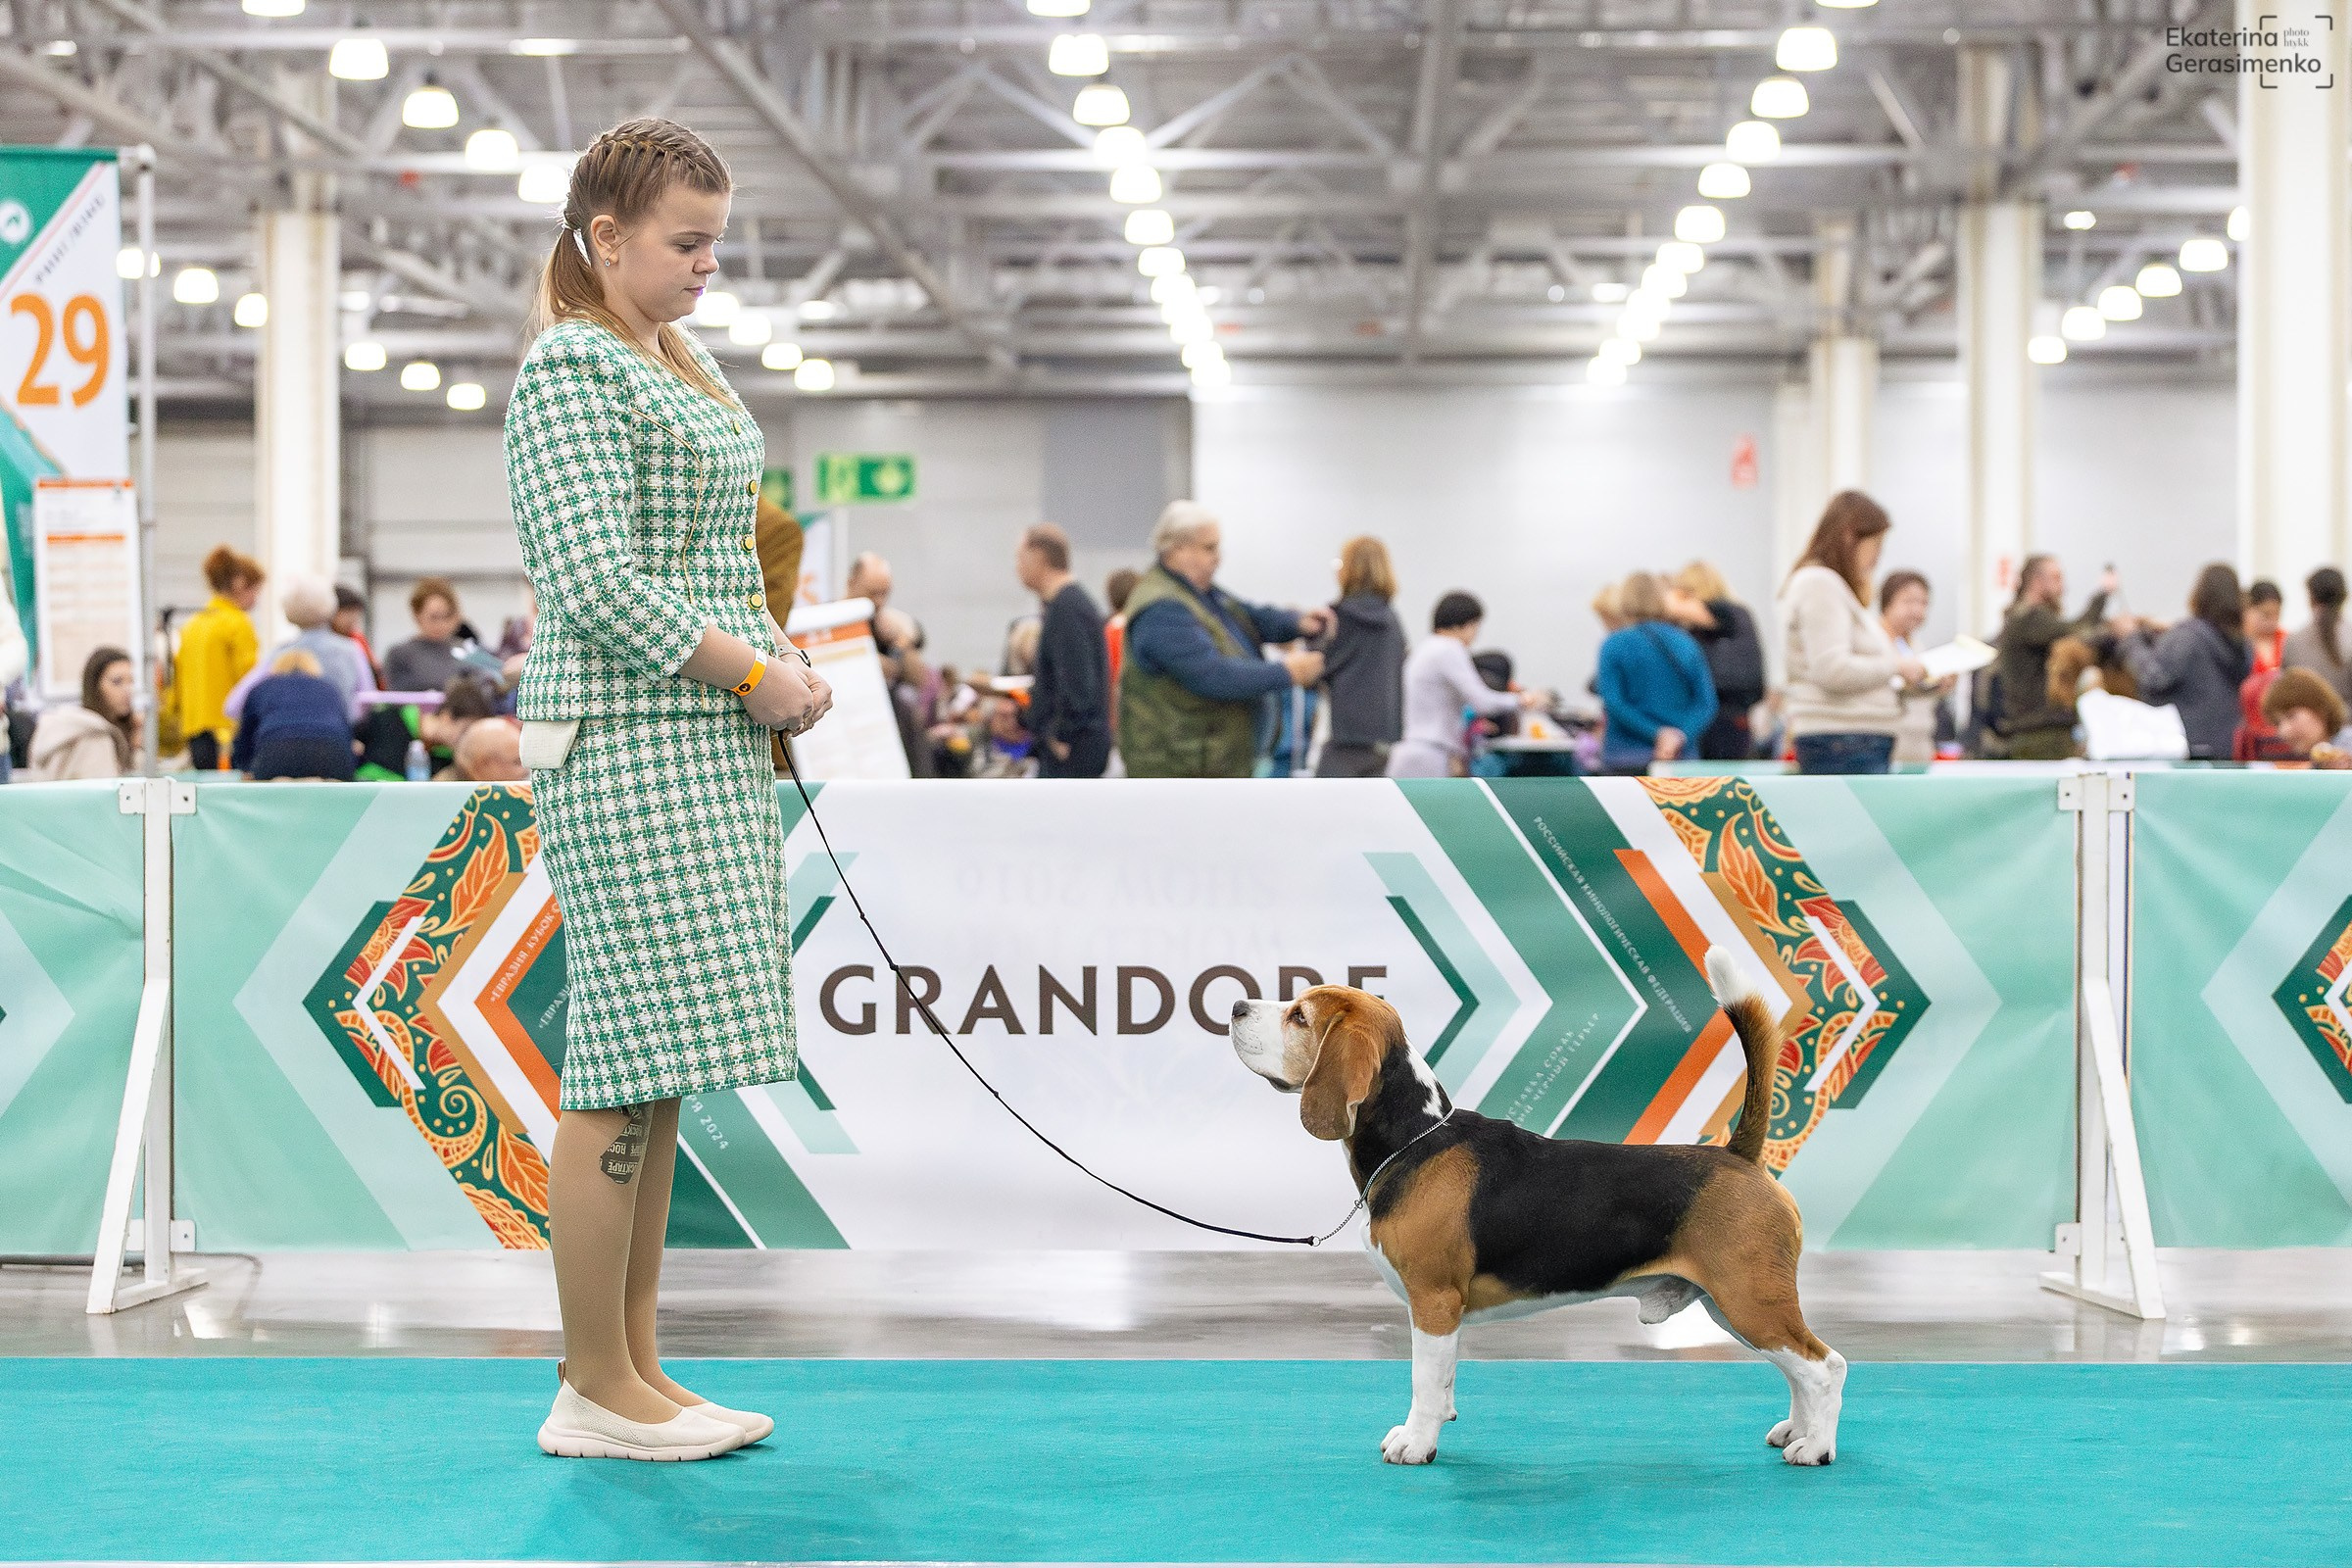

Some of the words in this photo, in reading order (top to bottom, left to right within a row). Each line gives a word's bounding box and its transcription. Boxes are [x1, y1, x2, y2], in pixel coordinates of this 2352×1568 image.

[11, 293, 111, 408] 29
[1534, 815, 1585, 884] РОССИЙСКАЯ
[526, 912, 555, 951] КУБОК
[700, 1115, 729, 1151] 2024
